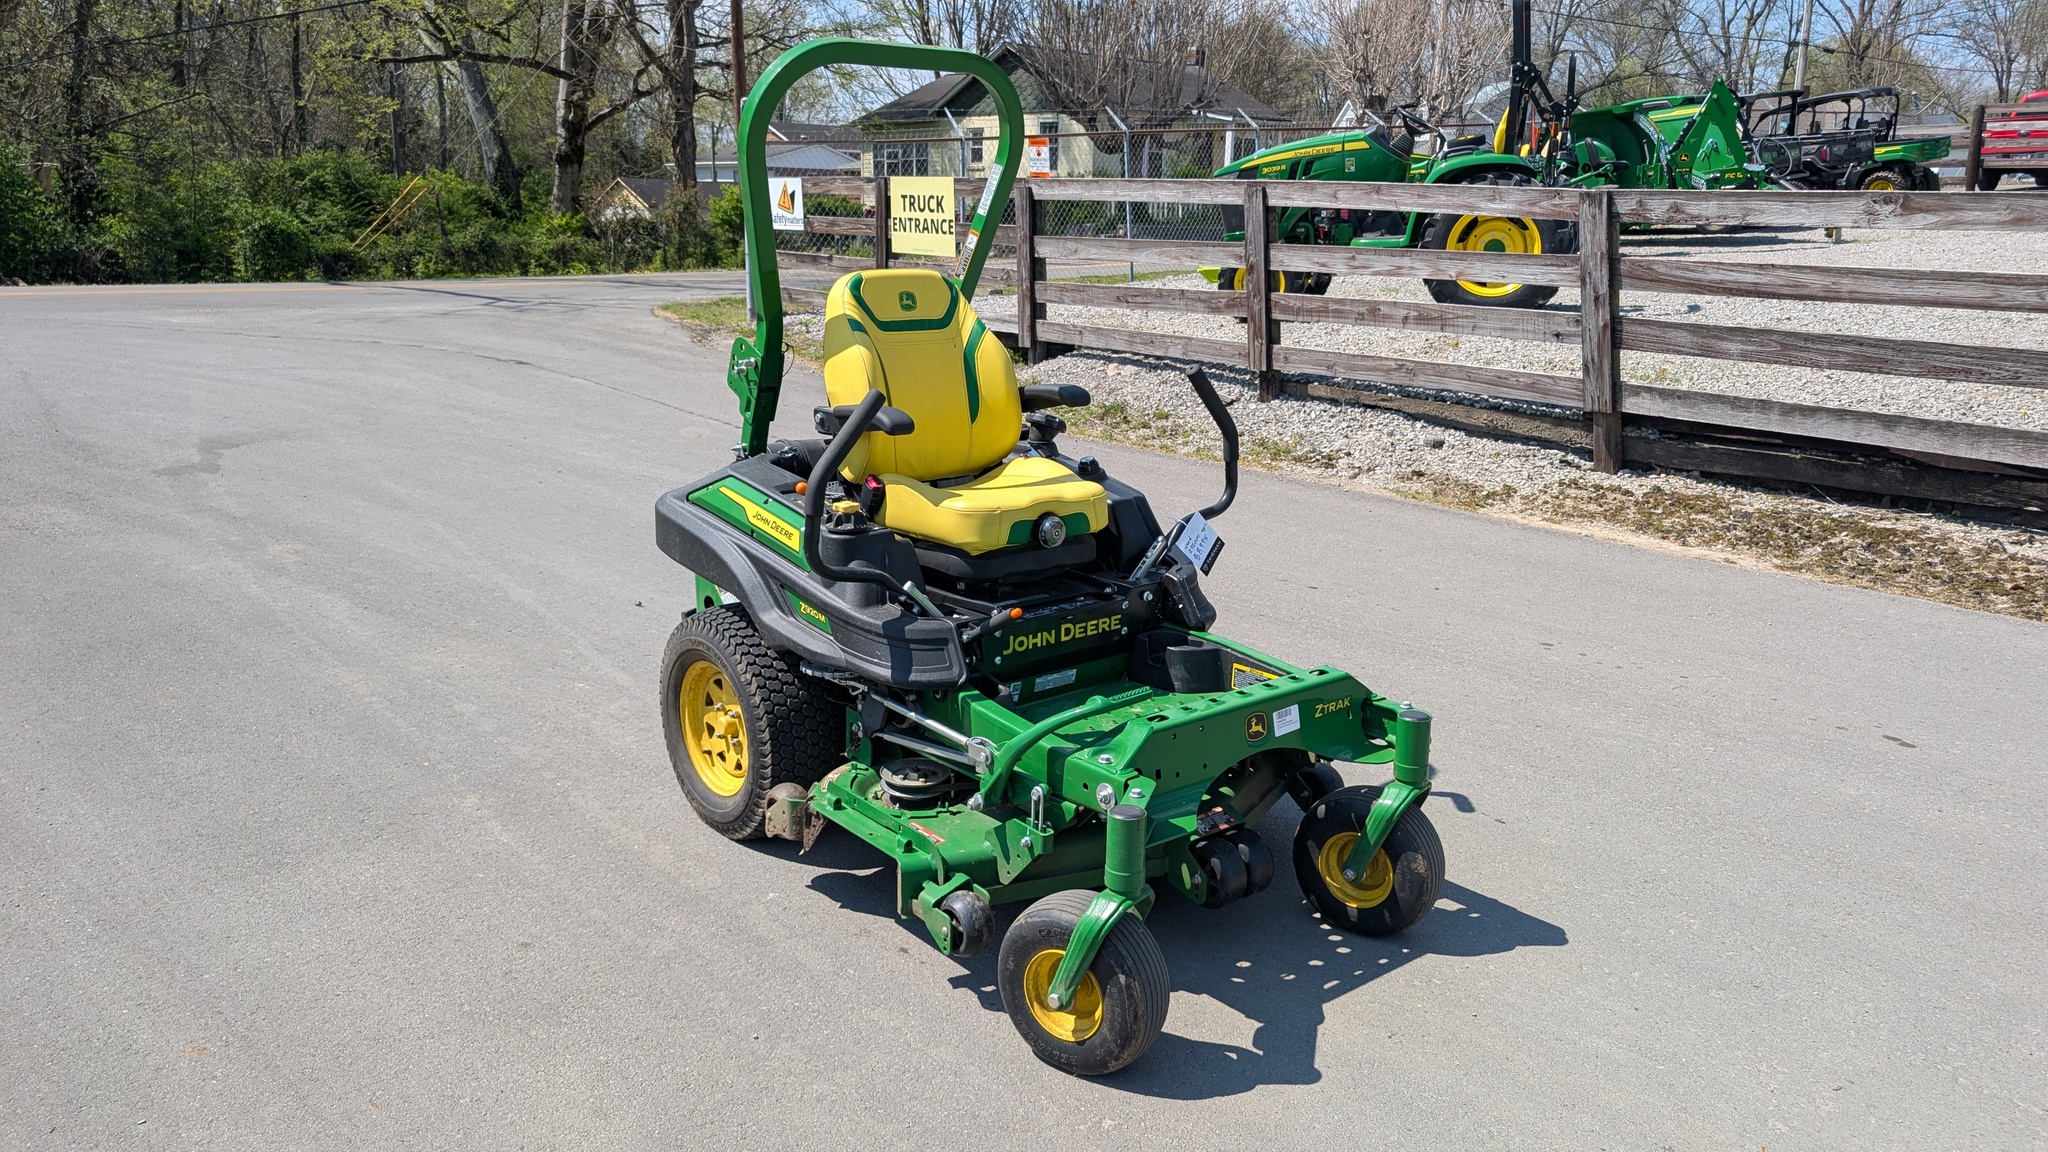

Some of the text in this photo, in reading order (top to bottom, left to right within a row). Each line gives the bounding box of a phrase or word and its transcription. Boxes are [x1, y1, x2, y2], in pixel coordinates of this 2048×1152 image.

[1292, 147, 1336, 158] JOHN DEERE
[900, 194, 945, 214] TRUCK
[892, 216, 954, 236] ENTRANCE
[752, 511, 794, 541] JOHN DEERE
[798, 601, 826, 624] Z920M
[1002, 614, 1122, 655] JOHN DEERE
[1314, 696, 1351, 719] ZTRAK
